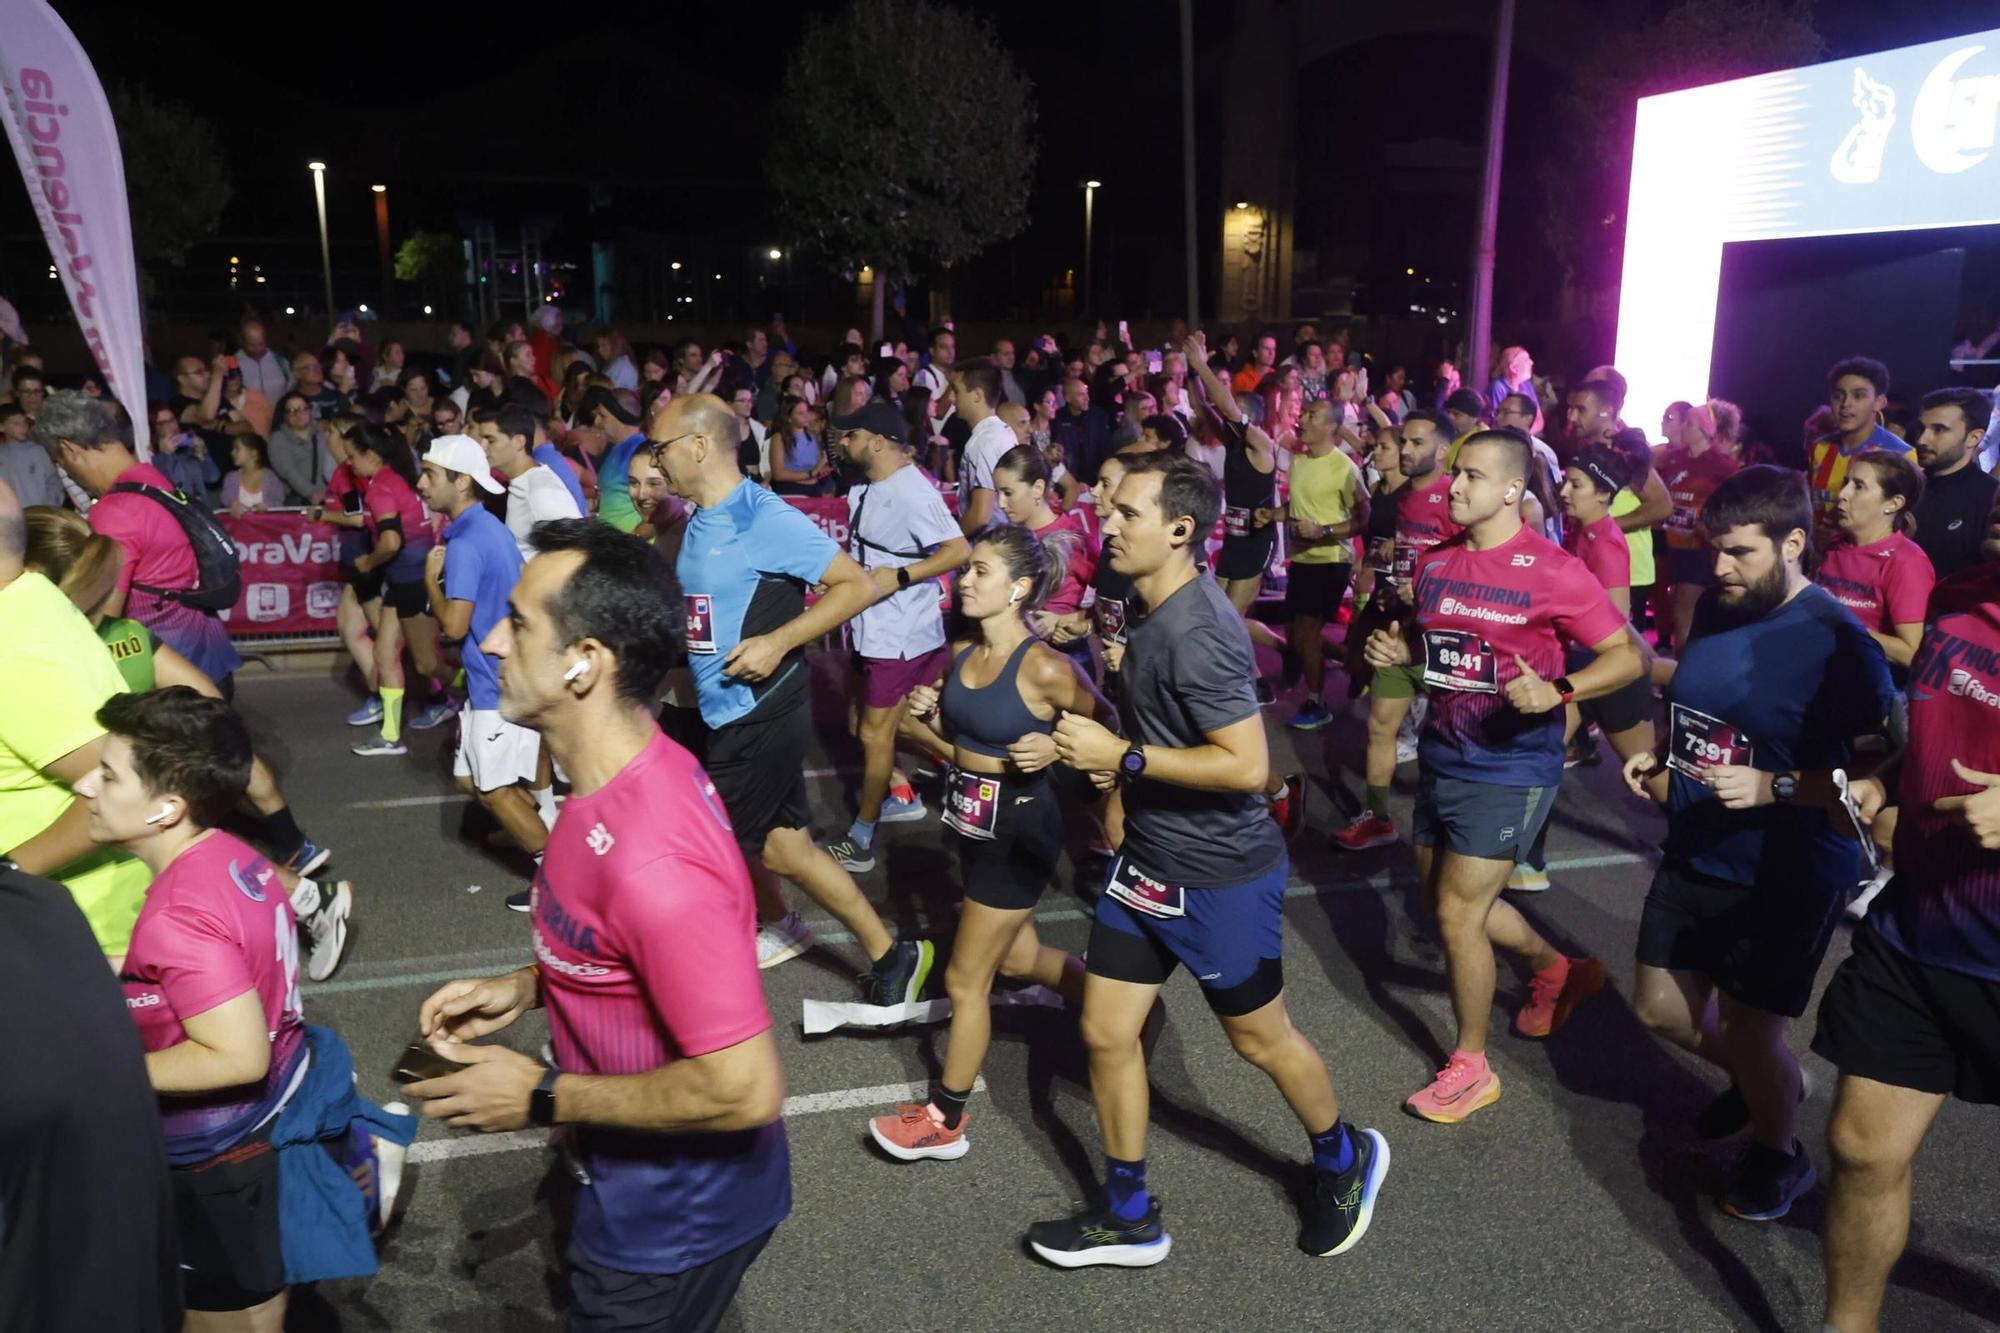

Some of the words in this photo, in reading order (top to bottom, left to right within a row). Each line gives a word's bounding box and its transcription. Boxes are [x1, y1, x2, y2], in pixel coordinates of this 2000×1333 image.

[1446, 580, 1531, 609] NOCTURNA
[1453, 602, 1528, 625] FibraValencia
[1439, 648, 1481, 671] 8941
[1685, 732, 1732, 765] 7391
